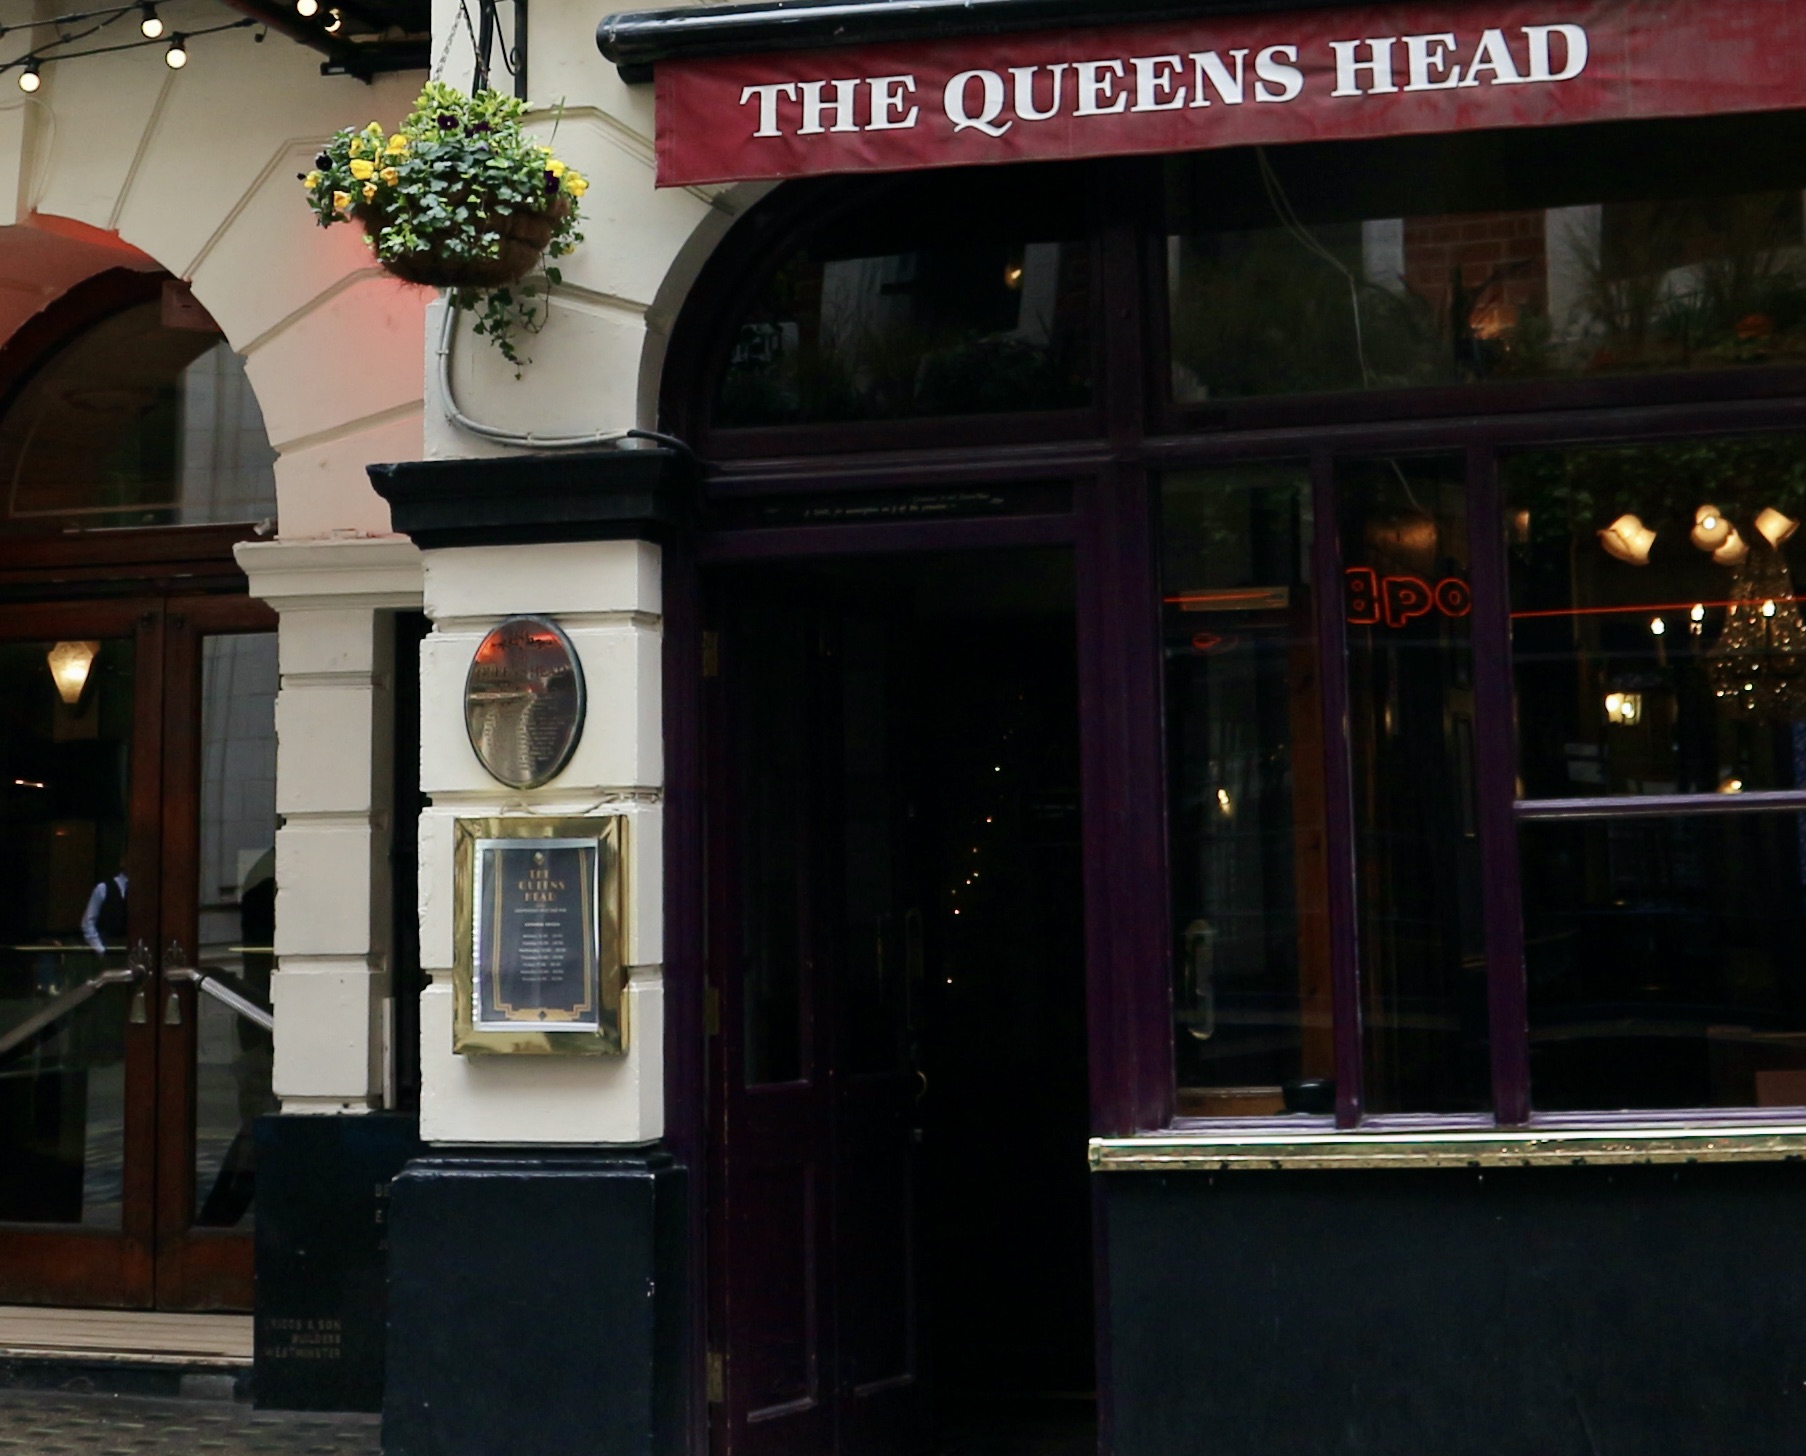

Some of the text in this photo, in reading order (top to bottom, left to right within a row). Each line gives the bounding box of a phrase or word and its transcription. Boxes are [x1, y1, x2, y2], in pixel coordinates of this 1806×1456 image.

[738, 23, 1590, 140] THE QUEENS HEAD
